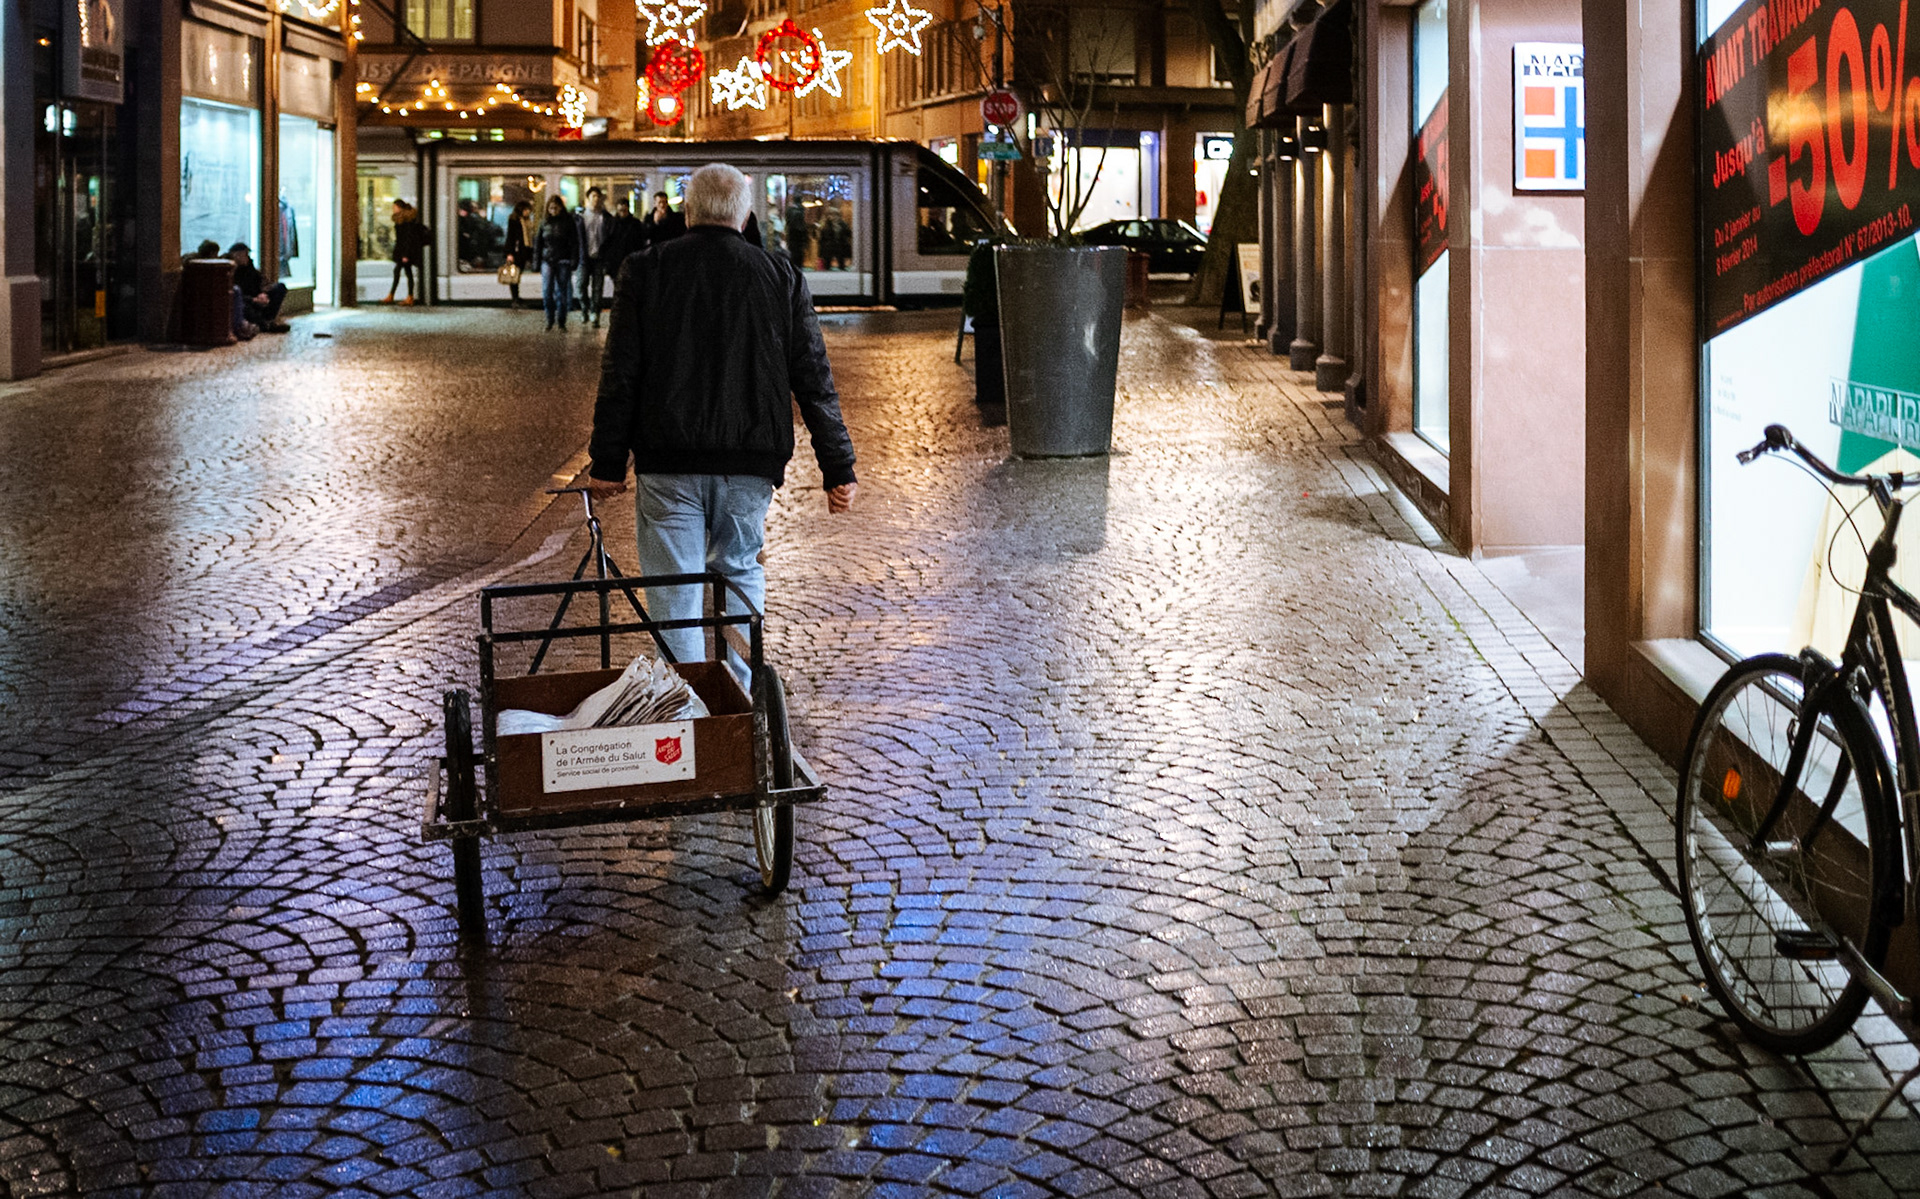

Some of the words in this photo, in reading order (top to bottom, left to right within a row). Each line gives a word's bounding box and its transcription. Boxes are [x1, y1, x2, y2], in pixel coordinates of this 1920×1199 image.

[1706, 23, 1745, 110] AVANT
[985, 103, 1016, 115] STOP
[1768, 0, 1920, 236] -50%
[1713, 117, 1765, 189] Jusqu'à
[1715, 228, 1724, 248] Du
[1724, 222, 1730, 242] 2
[1729, 210, 1751, 242] janvier
[1742, 234, 1758, 261] 2014
[1743, 292, 1755, 313] Par
[1756, 269, 1799, 306] autorisation
[1800, 241, 1844, 288] préfectoral
[556, 746, 567, 756] La
[570, 741, 632, 754] Congrégation
[556, 758, 568, 767] de
[570, 755, 606, 766] l'Armée
[608, 753, 620, 762] du
[622, 751, 646, 761] Salut
[557, 770, 581, 778] Service
[582, 767, 600, 775] social
[611, 763, 640, 774] proximité
